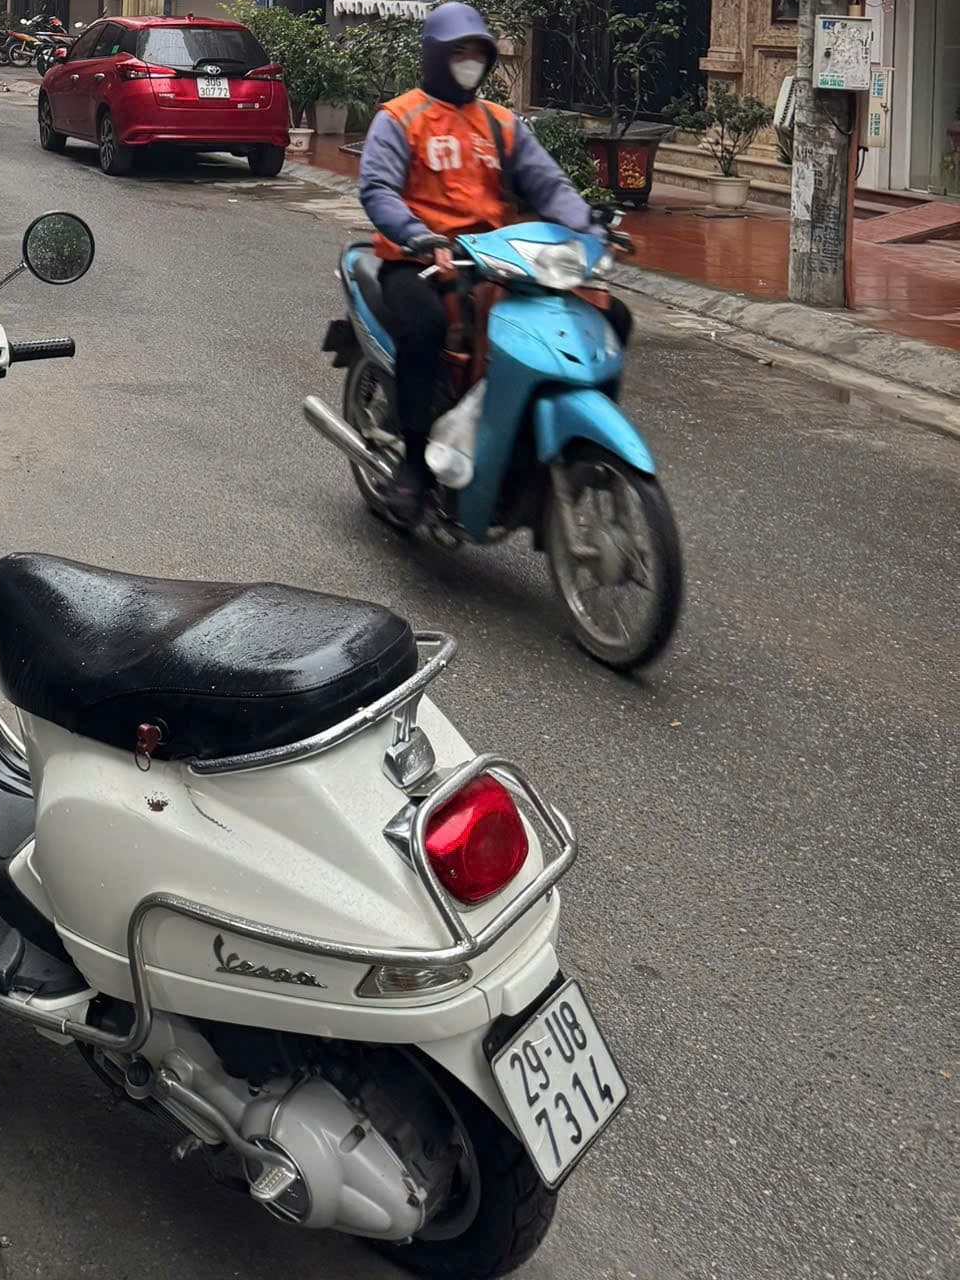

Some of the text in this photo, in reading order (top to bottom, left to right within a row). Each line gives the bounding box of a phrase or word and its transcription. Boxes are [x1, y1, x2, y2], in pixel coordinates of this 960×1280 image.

[213, 933, 329, 989] Vespa
[509, 1001, 587, 1107] 29-U8
[534, 1054, 615, 1168] 7314
